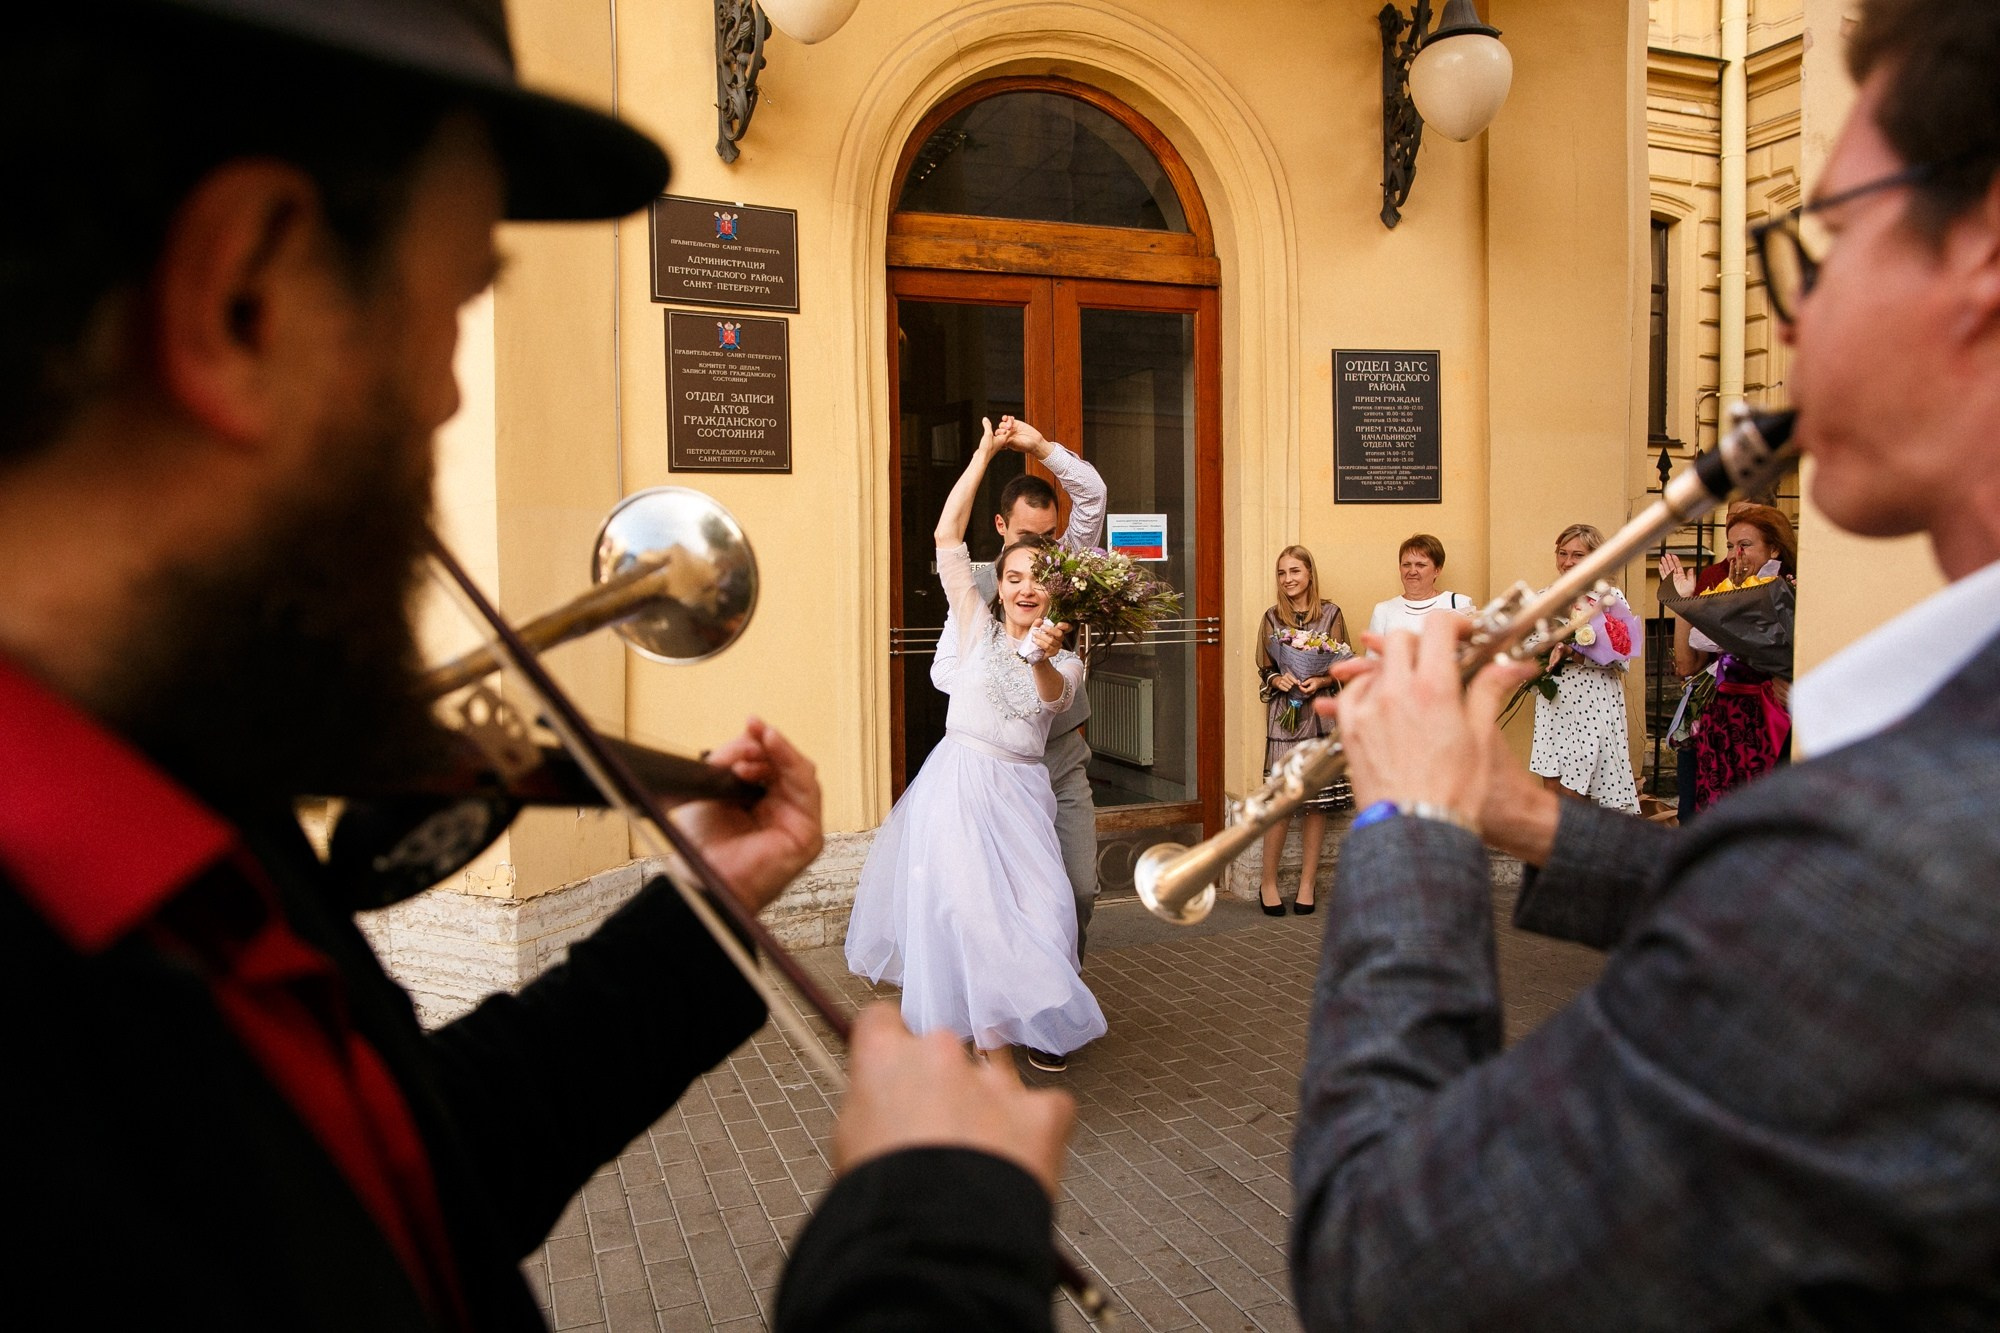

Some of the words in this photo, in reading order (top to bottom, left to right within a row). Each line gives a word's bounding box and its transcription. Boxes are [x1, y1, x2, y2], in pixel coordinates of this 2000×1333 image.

[670, 239, 720, 249] ПРАВИТЕЛЬСТВО
[687, 255, 766, 270] АДМИНИСТРАЦИЯ
[668, 266, 747, 280] ПЕТРОГРАДСКОГО
[750, 273, 784, 283] РАЙОНА
[674, 349, 724, 357] ПРАВИТЕЛЬСТВО
[1345, 360, 1390, 373] ОТДЕЛ
[1394, 361, 1428, 372] ЗАГС
[1344, 373, 1430, 383] ПЕТРОГРАДСКОГО
[1368, 381, 1406, 391] РАЙОНА
[685, 391, 725, 403] ОТДЕЛ
[730, 392, 775, 404] ЗАПИСИ
[1383, 396, 1421, 404] ГРАЖДАН
[712, 404, 750, 415] АКТОВ
[683, 415, 777, 427] ГРАЖДАНСКОГО
[696, 428, 765, 439] СОСТОЯНИЯ
[1363, 441, 1392, 449] ОТДЕЛА
[686, 448, 747, 456] ПЕТРОГРАДСКОГО
